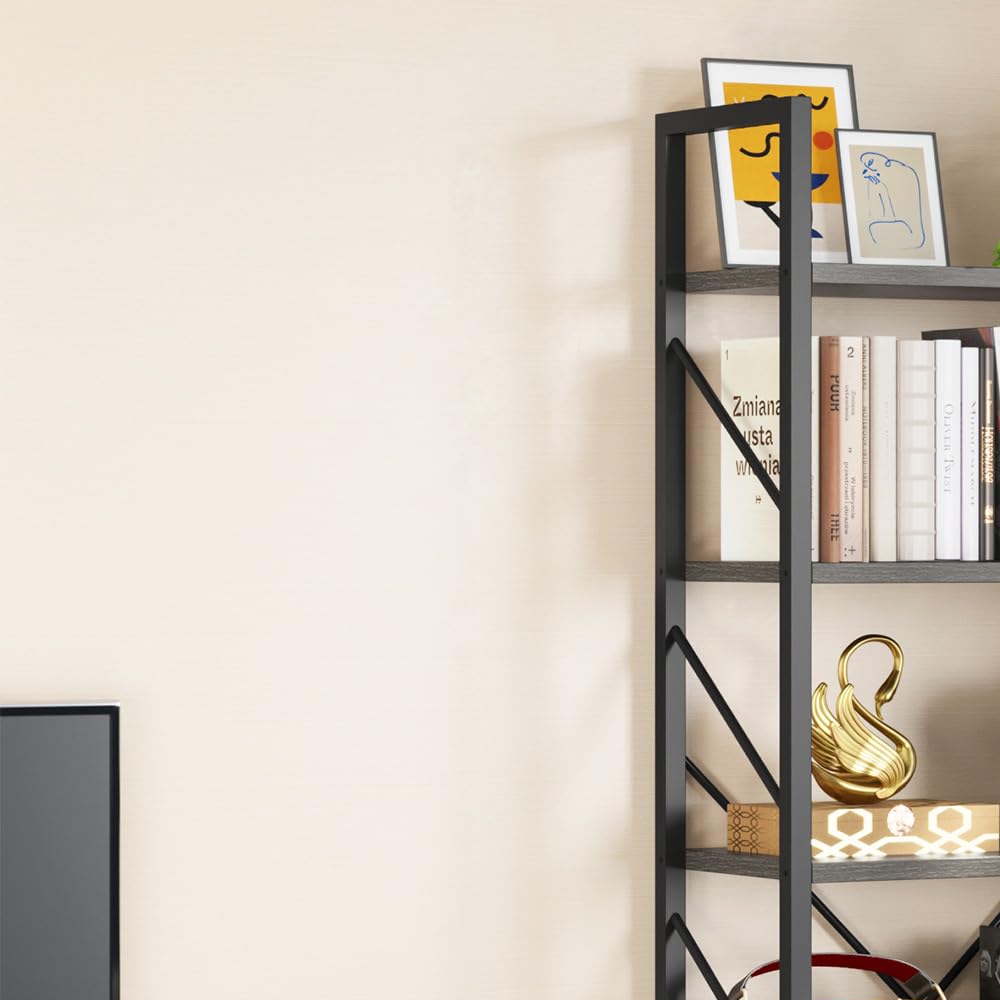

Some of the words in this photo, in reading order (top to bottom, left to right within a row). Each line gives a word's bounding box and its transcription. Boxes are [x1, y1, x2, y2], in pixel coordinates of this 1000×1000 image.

[847, 346, 855, 358] 2
[733, 395, 780, 417] Zmiana
[743, 426, 773, 446] usta
